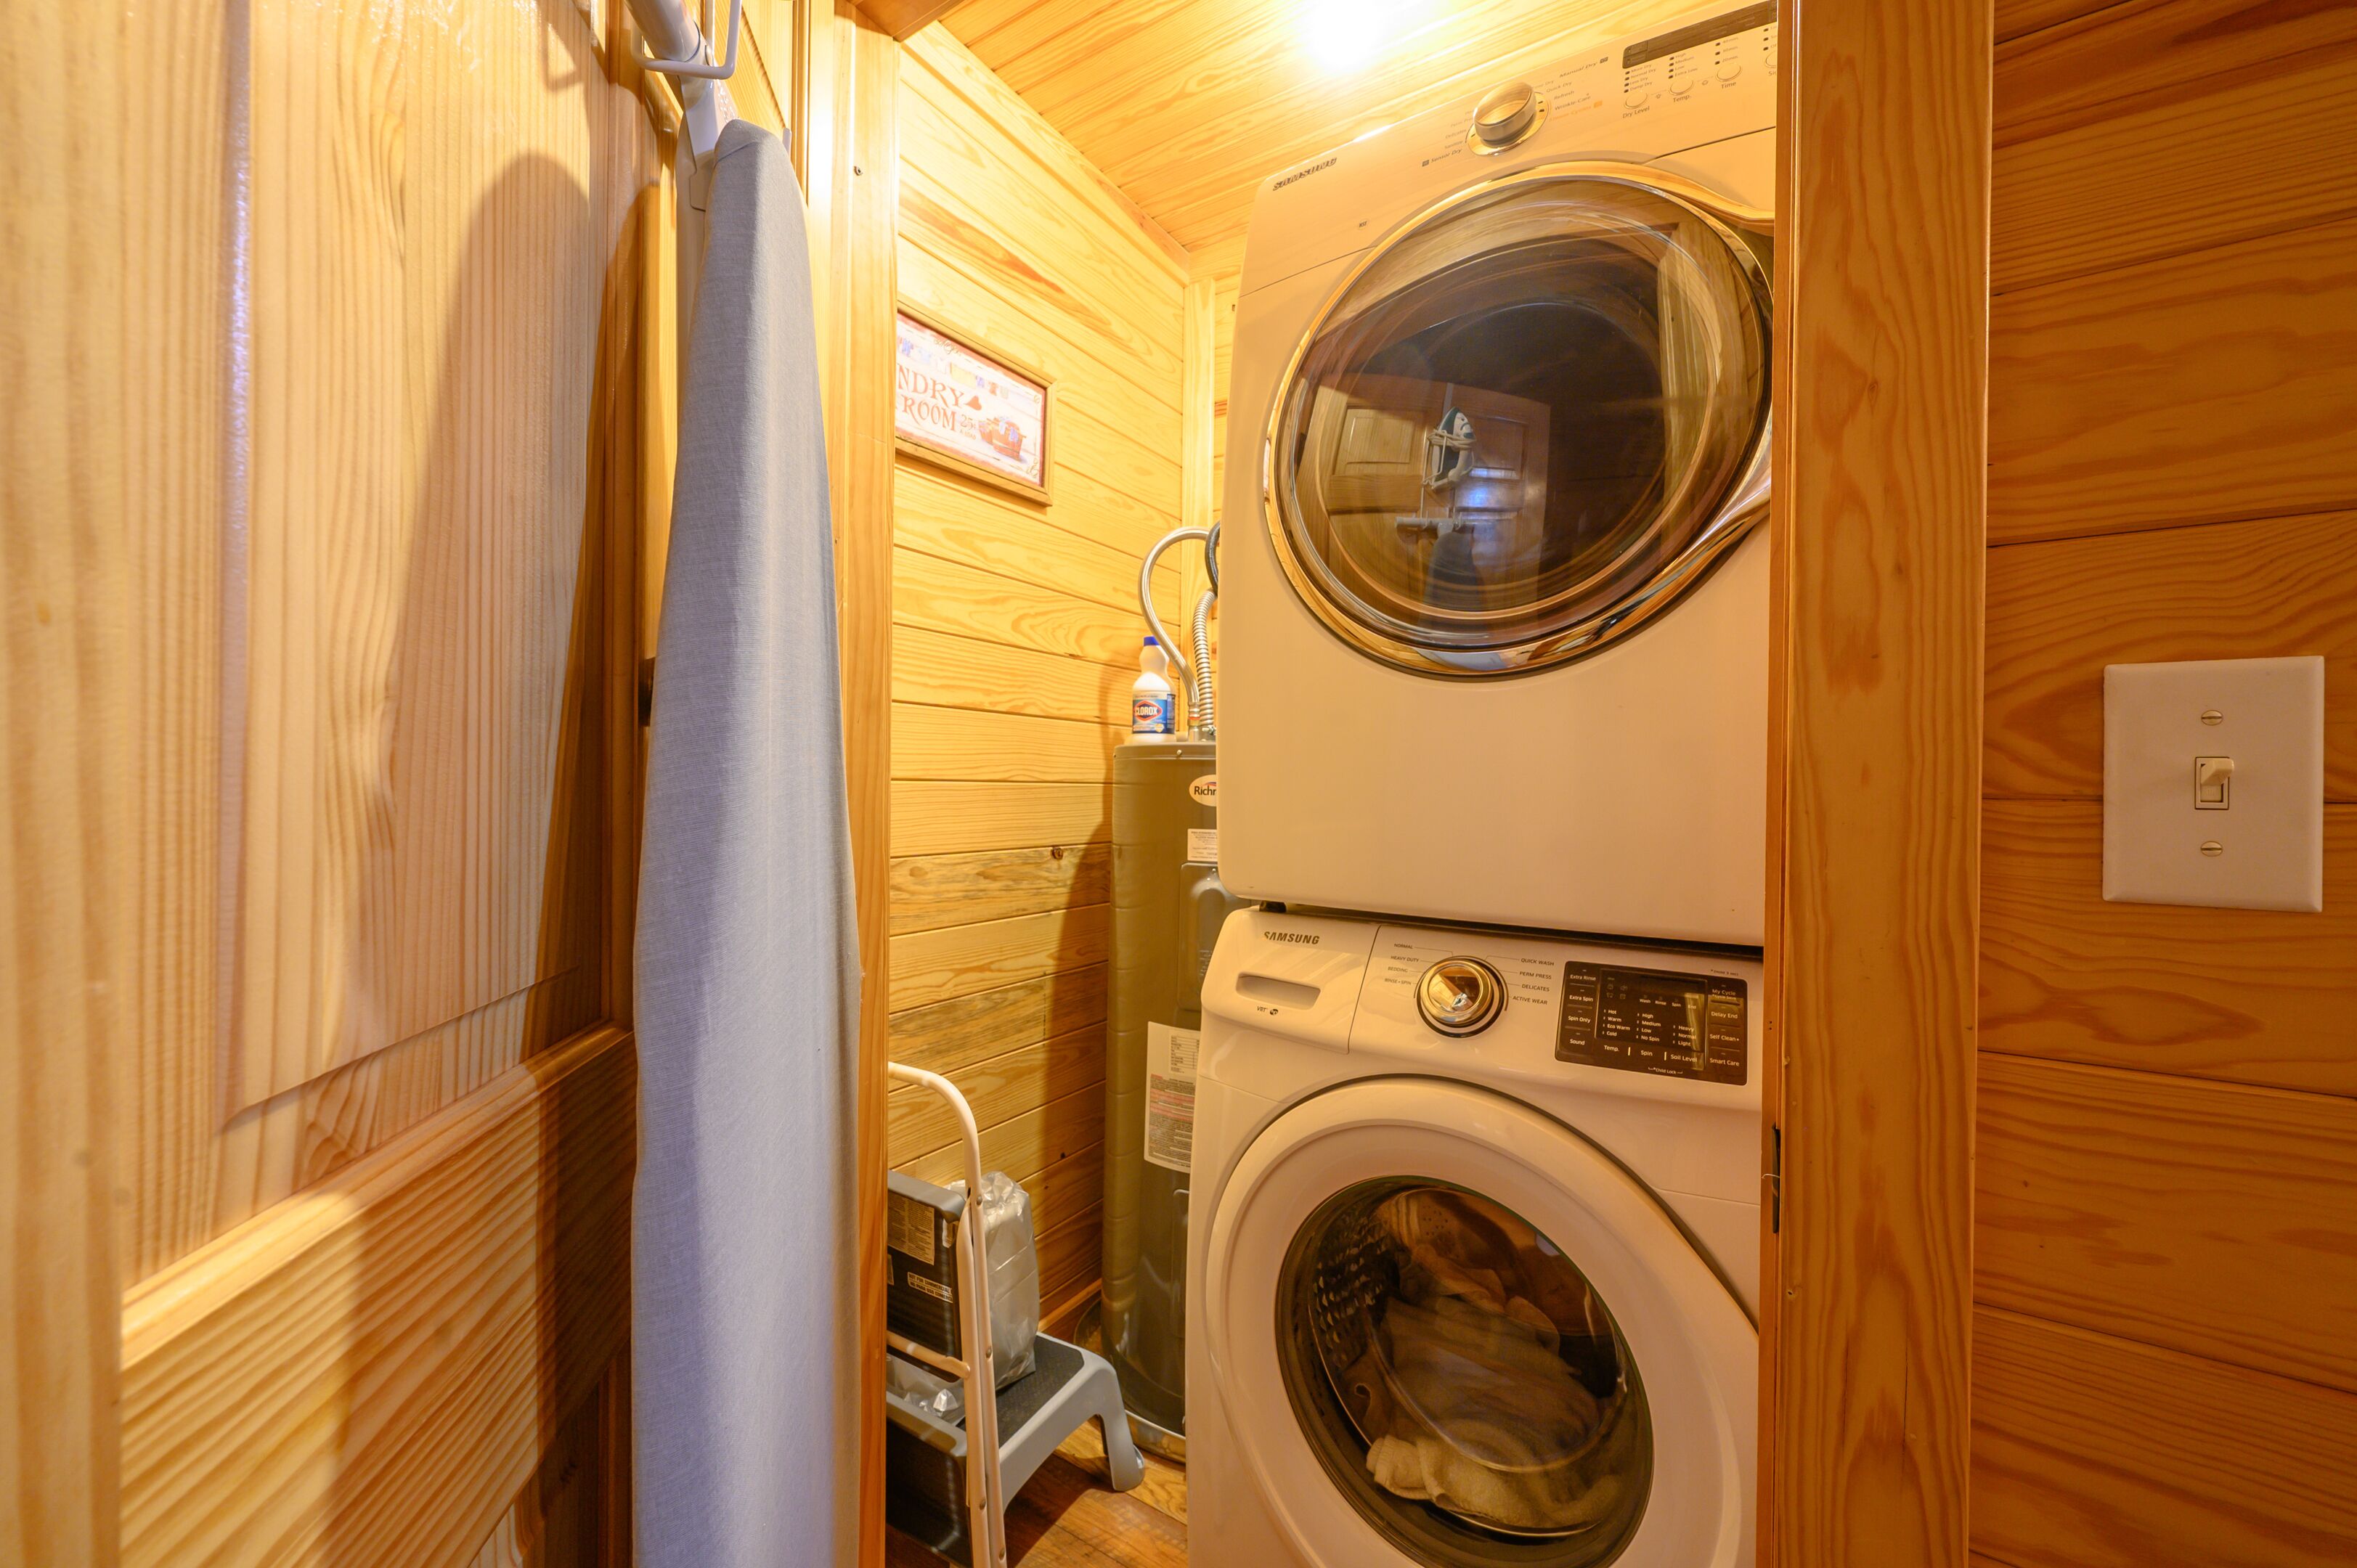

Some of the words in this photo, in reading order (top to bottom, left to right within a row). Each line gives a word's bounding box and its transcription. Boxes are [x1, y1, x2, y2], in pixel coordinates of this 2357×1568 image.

[1559, 66, 1584, 78] Manual
[1585, 61, 1597, 70] Dry
[1553, 90, 1574, 100] Refresh
[1555, 101, 1576, 111] Wrinkle
[1634, 106, 1650, 115] Level
[1430, 152, 1451, 163] Sensor
[1272, 158, 1338, 191] SAMSUNG
[900, 394, 956, 433] ROOM
[1135, 706, 1159, 716] CLOROX
[1263, 931, 1320, 945] SAMSUNG
[1521, 984, 1550, 992] DELICATES
